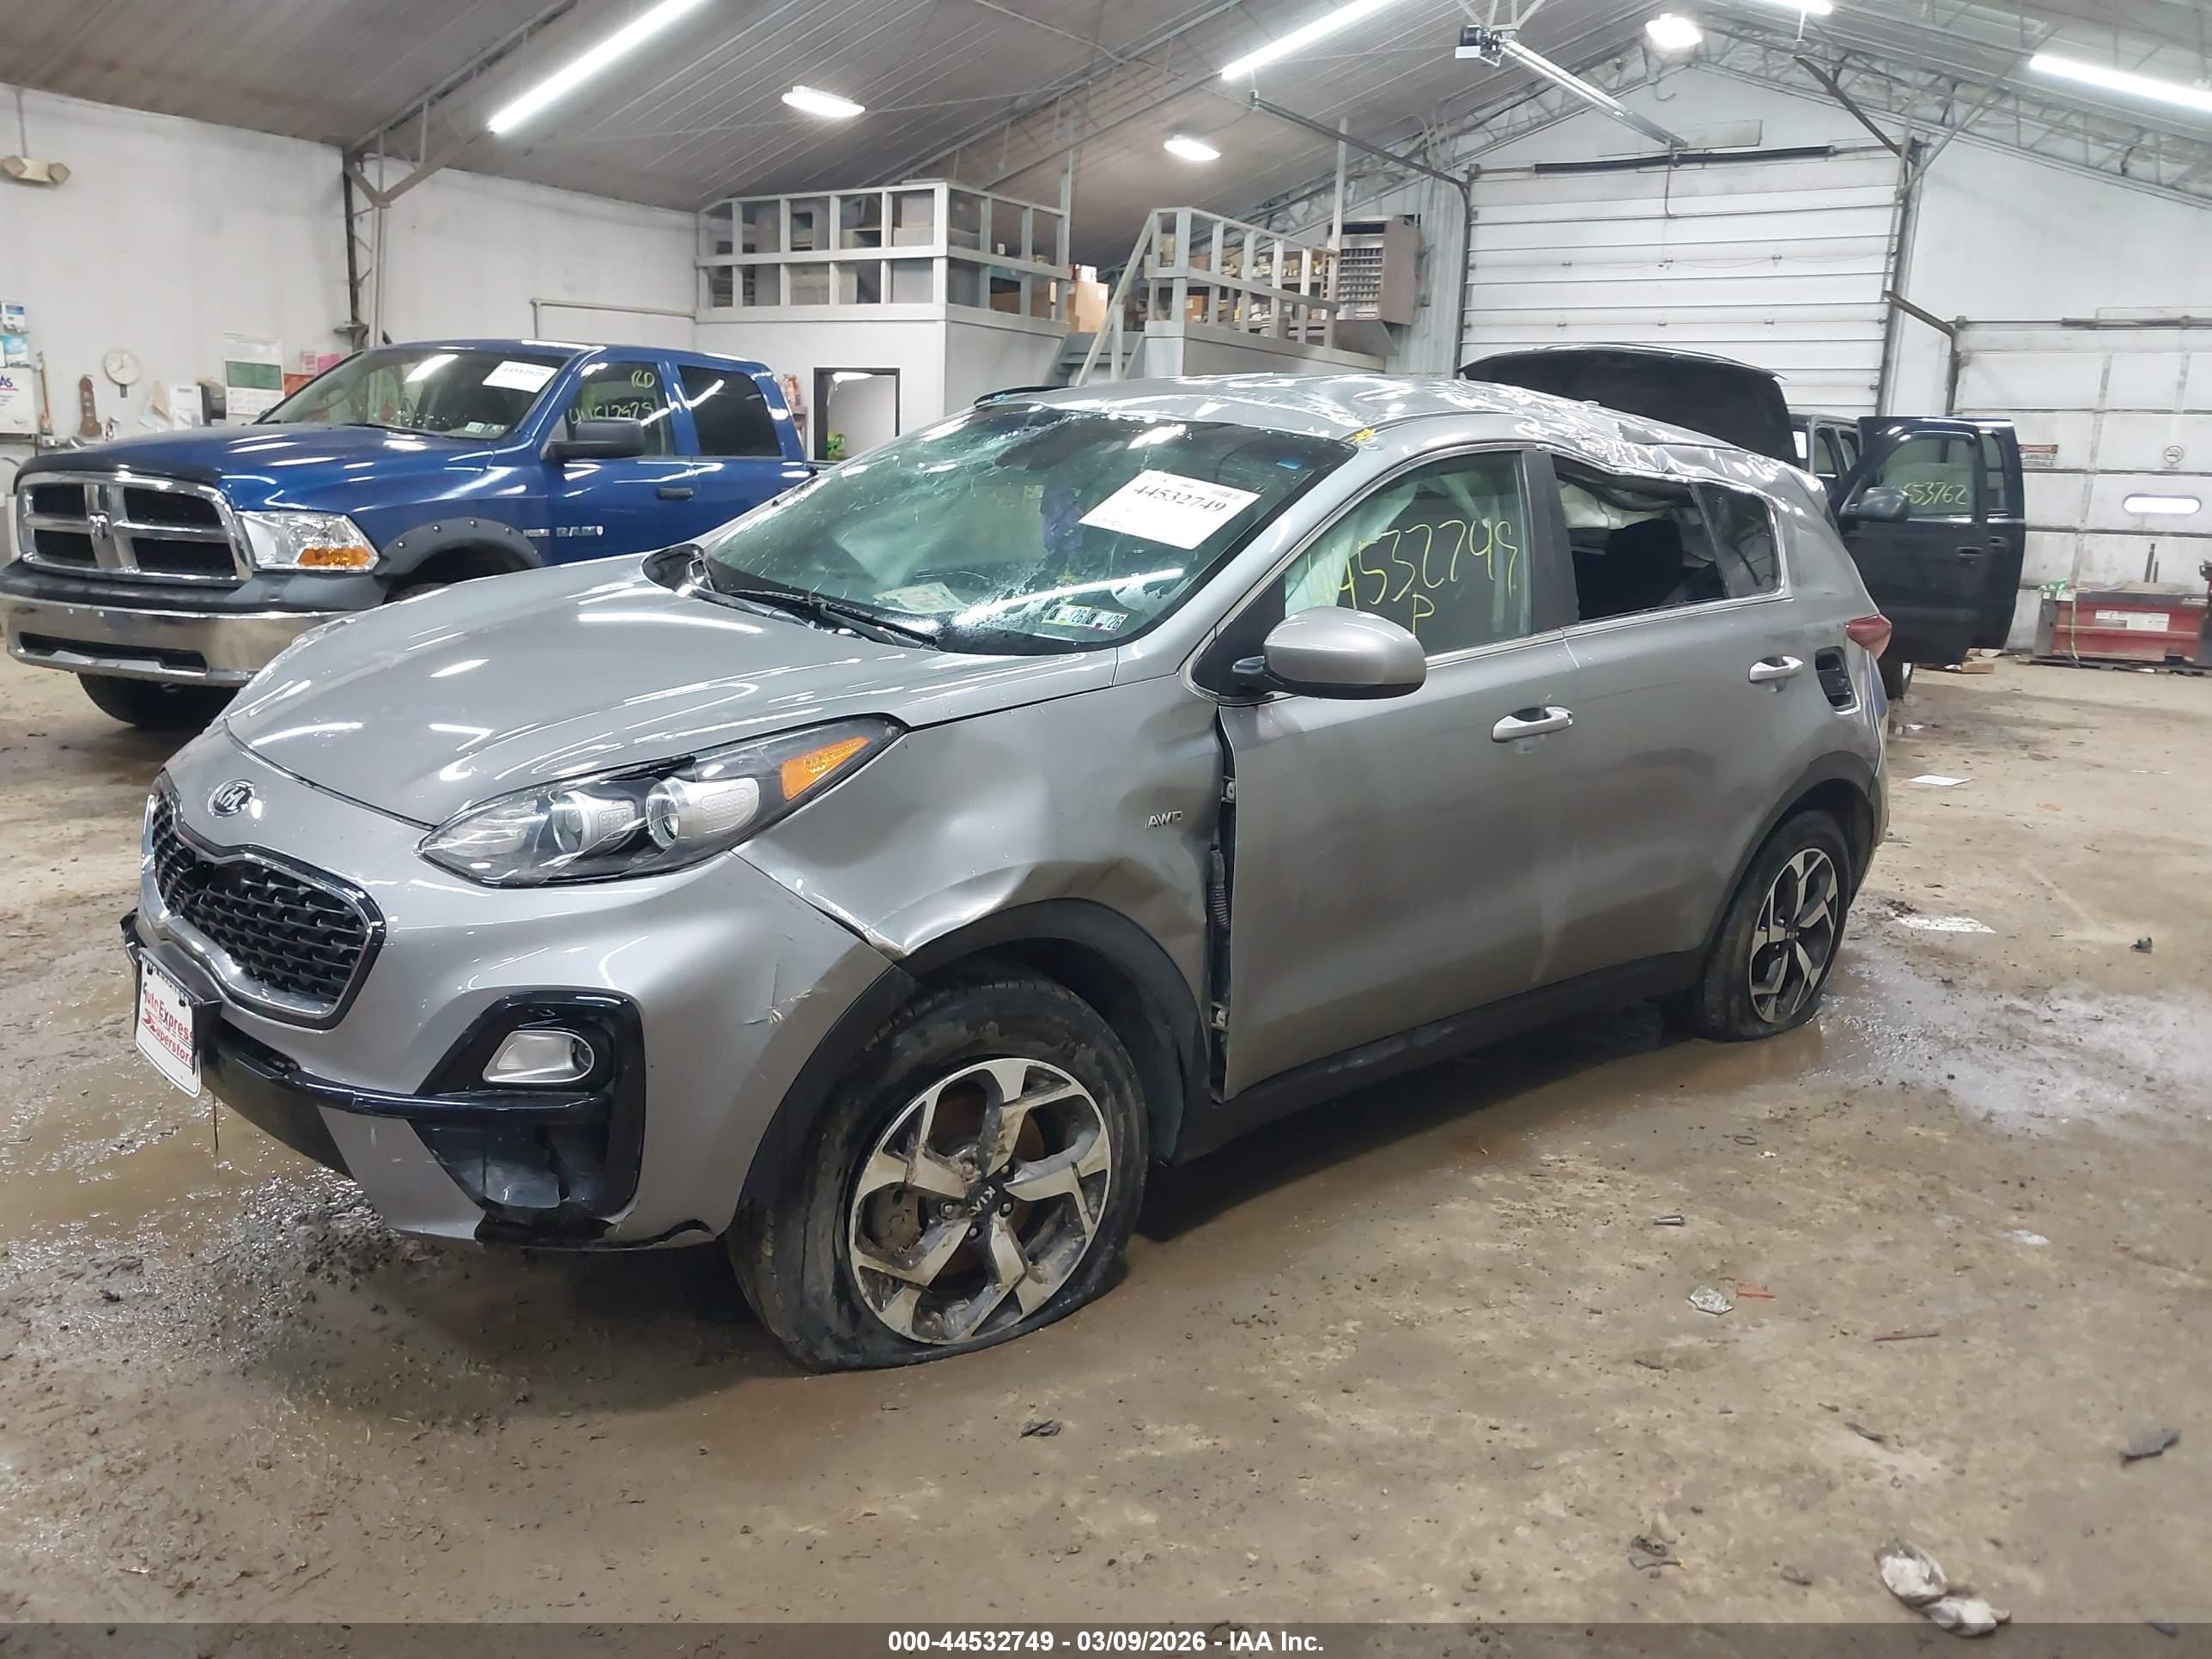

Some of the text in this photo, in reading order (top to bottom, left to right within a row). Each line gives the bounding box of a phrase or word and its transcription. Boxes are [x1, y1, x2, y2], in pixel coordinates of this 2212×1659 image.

[1133, 484, 1227, 513] 44532749
[1048, 608, 1087, 623] 3 26
[1085, 612, 1124, 629] 3 26
[1412, 591, 1435, 635] P
[969, 1185, 996, 1212] KIA
